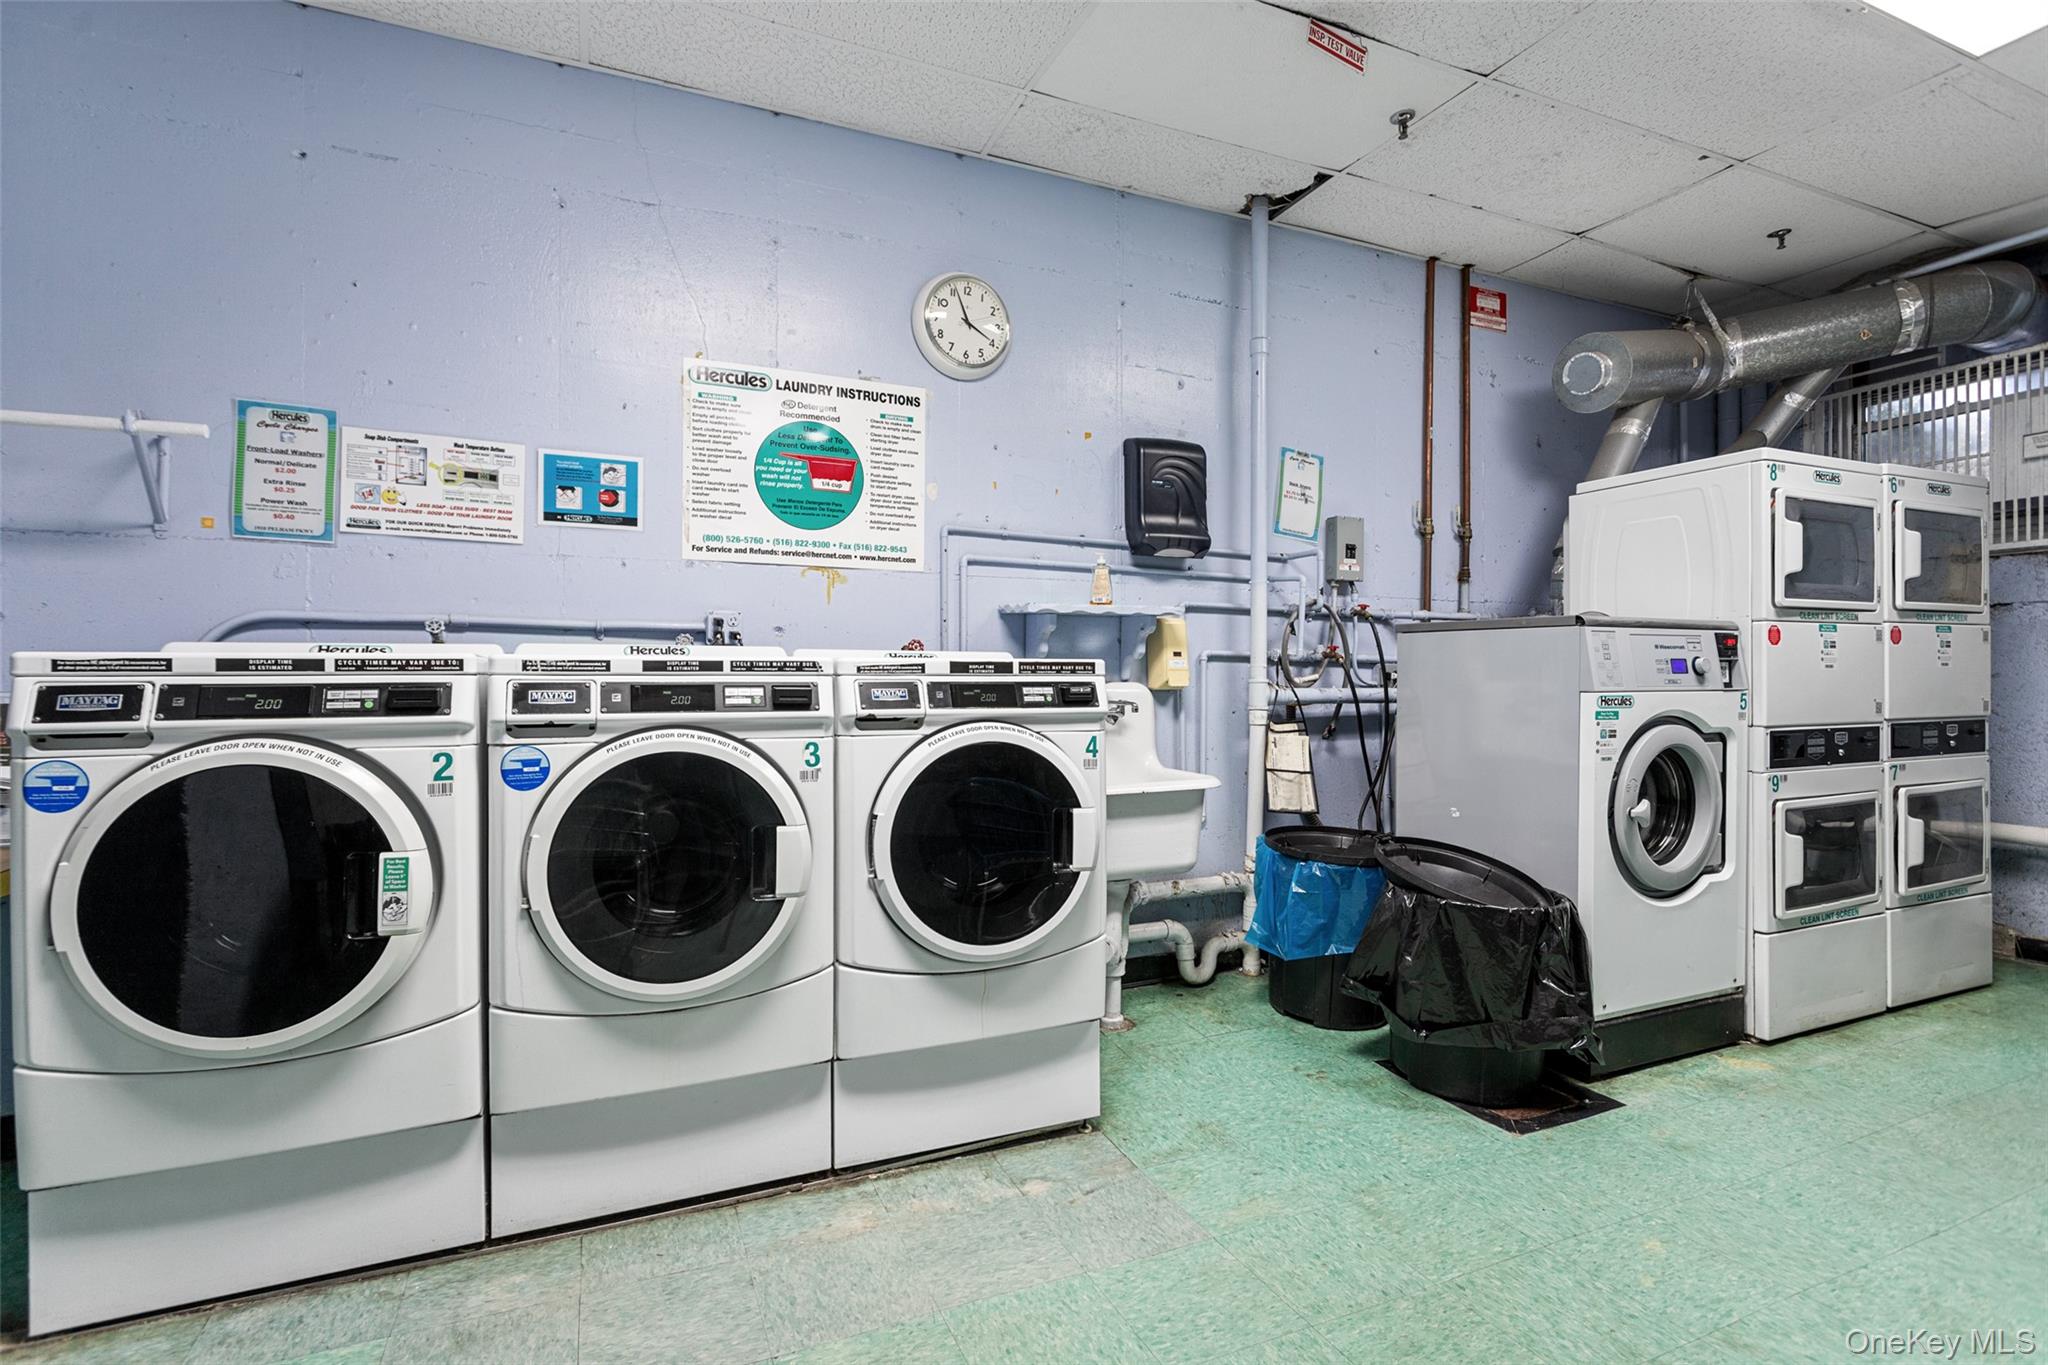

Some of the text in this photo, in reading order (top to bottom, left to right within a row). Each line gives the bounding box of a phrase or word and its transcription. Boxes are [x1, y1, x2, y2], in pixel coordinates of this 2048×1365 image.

[1309, 26, 1365, 66] INSP. TEST VALVE
[950, 288, 956, 297] 11
[964, 286, 972, 296] 12
[981, 293, 984, 302] 1
[938, 298, 949, 308] 10
[990, 306, 996, 316] 2
[937, 329, 944, 339] 8
[948, 342, 955, 351] 7
[989, 339, 995, 348] 4
[963, 350, 969, 359] 6
[978, 349, 984, 358] 5
[696, 366, 921, 408] Hercules LAUNDRY INSTRUCTIONS
[797, 401, 837, 413] Detergent
[271, 410, 308, 422] Hercules
[780, 410, 840, 423] Recommended
[256, 420, 318, 433] Cycle Charges
[246, 445, 289, 455] Front-Load
[769, 441, 797, 449] Prevent
[1770, 463, 1777, 481] 8
[1816, 470, 1840, 483] Hercules
[1891, 477, 1897, 493] 6
[703, 534, 907, 553] (800) 526-5760 (516) 822-9300 Fax (516) 822-9543
[692, 544, 916, 563] For Service and Refunds: service@hercnet.com www.hercnet.com
[1835, 612, 1858, 621] SCREEN
[318, 645, 387, 654] Hercules
[630, 646, 686, 656] Hercules
[531, 691, 573, 700] MAYTAG
[873, 689, 907, 697] MAYTAG
[980, 693, 997, 702] 2.00
[62, 696, 118, 705] MAYTAG
[254, 699, 282, 709] 2.00
[671, 696, 691, 705] 2.00
[1600, 696, 1632, 706] Hercules
[1740, 693, 1747, 710] 5
[606, 741, 630, 754] PLEASE
[633, 735, 653, 744] LEAVE
[697, 735, 716, 744] WHEN
[717, 740, 731, 748] NOT
[739, 748, 751, 759] USE
[1085, 735, 1098, 758] 4
[150, 754, 182, 771] PLEASE
[184, 746, 211, 759] LEAVE
[214, 742, 240, 751] DOOR
[268, 743, 294, 752] WHEN
[296, 747, 314, 757] NOT
[315, 752, 325, 760] IN
[326, 755, 343, 768] USE
[804, 741, 820, 768] 3
[432, 752, 454, 782] 2
[1891, 765, 1898, 780] 7
[1771, 774, 1779, 792] 9
[1917, 886, 1968, 902] CLEAN LINT SCREEN
[1800, 908, 1860, 926] CLEAN LINT SCREEN
